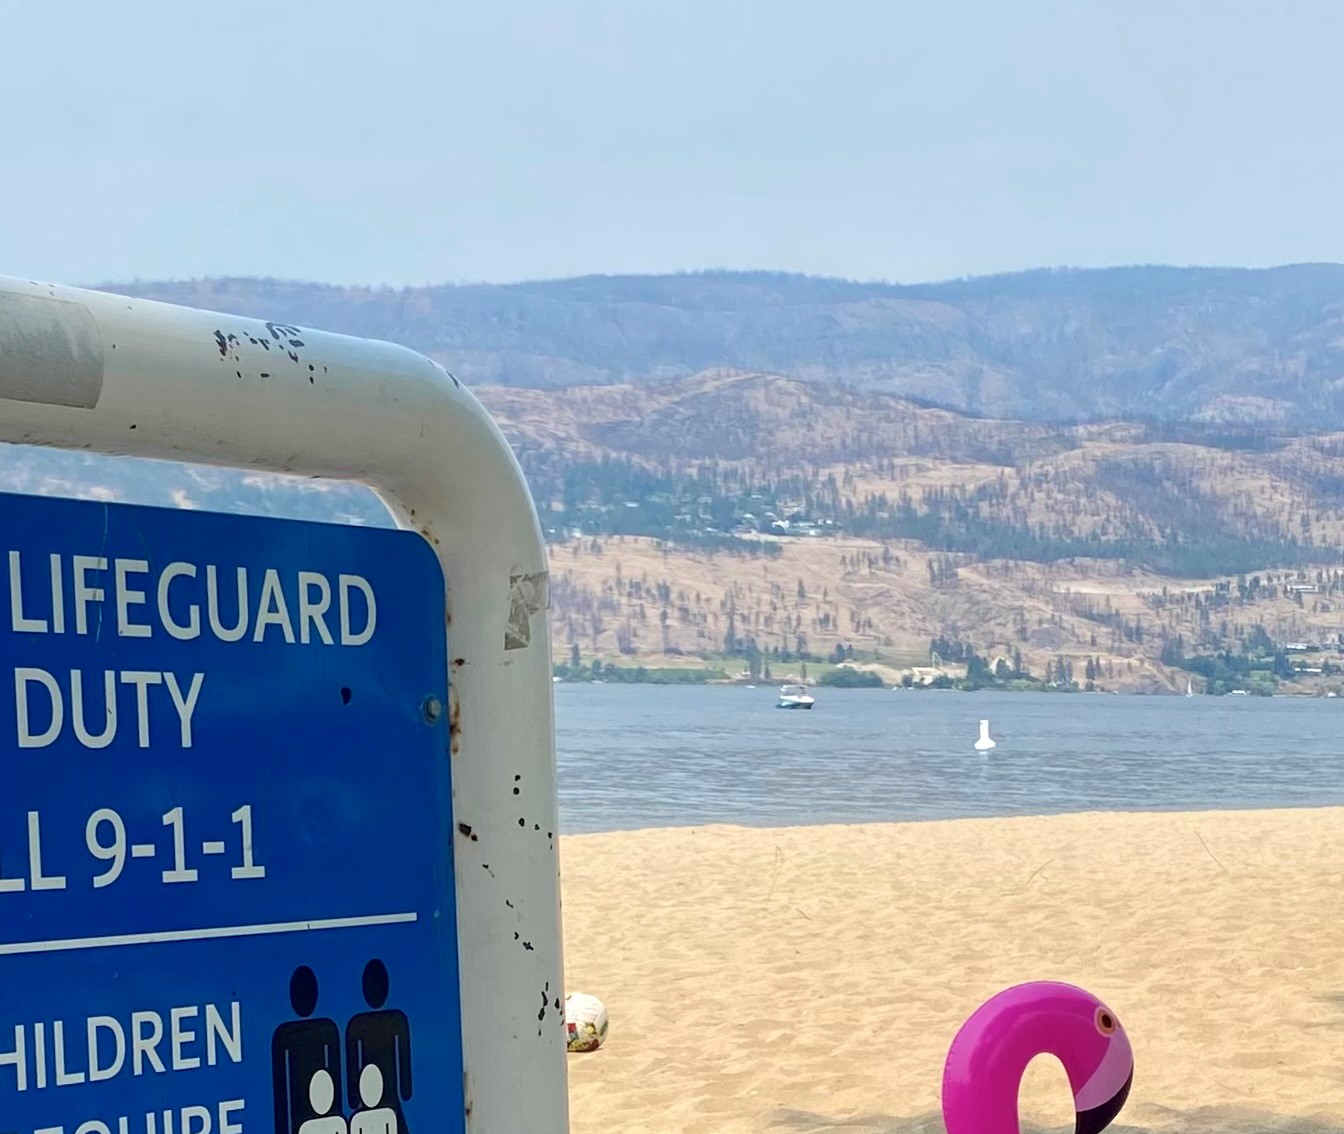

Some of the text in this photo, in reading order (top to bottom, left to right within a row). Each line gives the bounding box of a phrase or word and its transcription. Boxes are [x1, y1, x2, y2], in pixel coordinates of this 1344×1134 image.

[9, 550, 377, 646] LIFEGUARD
[15, 667, 205, 748] DUTY
[86, 806, 265, 887] 9-1-1
